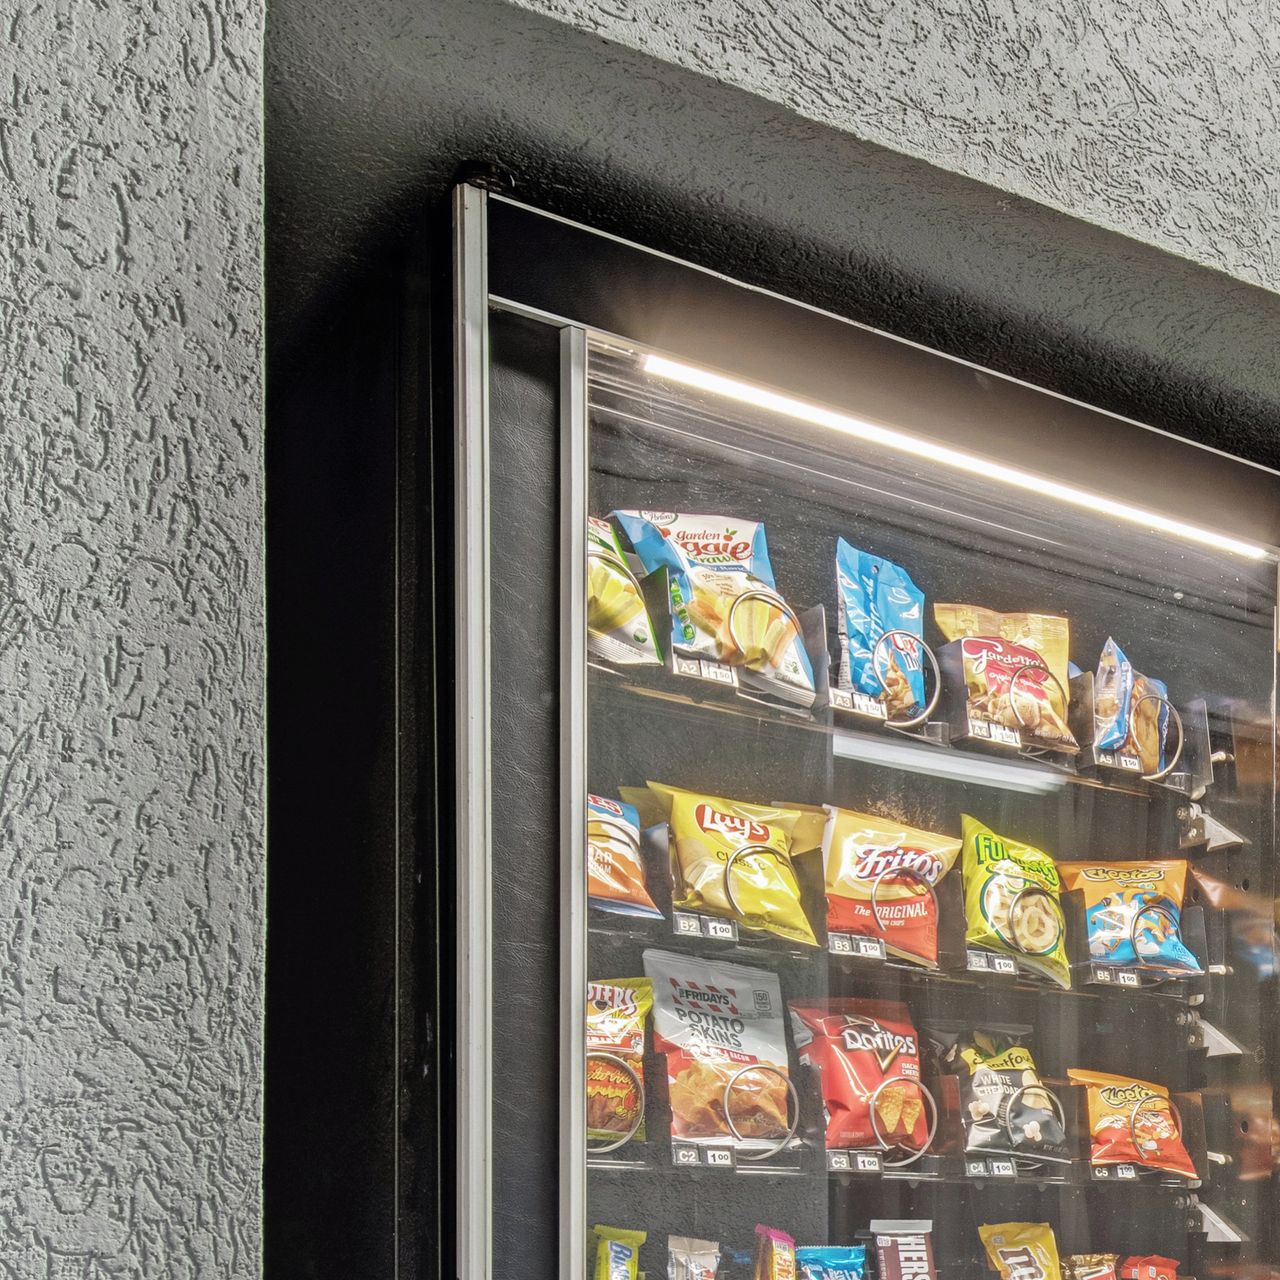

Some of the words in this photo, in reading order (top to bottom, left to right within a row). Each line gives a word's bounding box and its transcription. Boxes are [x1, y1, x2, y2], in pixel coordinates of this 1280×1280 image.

[676, 528, 720, 541] garden
[680, 664, 698, 675] A2
[835, 696, 850, 707] A3
[973, 727, 987, 737] A4
[1100, 754, 1112, 764] A5
[855, 846, 942, 882] Fritos
[1086, 867, 1162, 880] Cheetos
[854, 904, 870, 916] The
[876, 902, 928, 919] ORIGINAL
[679, 921, 697, 932] B2
[835, 941, 849, 951] B3
[1097, 971, 1111, 981] B5
[684, 989, 730, 1006] FRIDAYS
[674, 1007, 745, 1035] POTATO
[689, 1023, 743, 1048] SKINS
[841, 1029, 917, 1055] Doritos
[981, 1074, 1012, 1086] WHITE
[679, 1151, 696, 1163] C2
[831, 1158, 847, 1168] C3
[1095, 1168, 1109, 1177] C5
